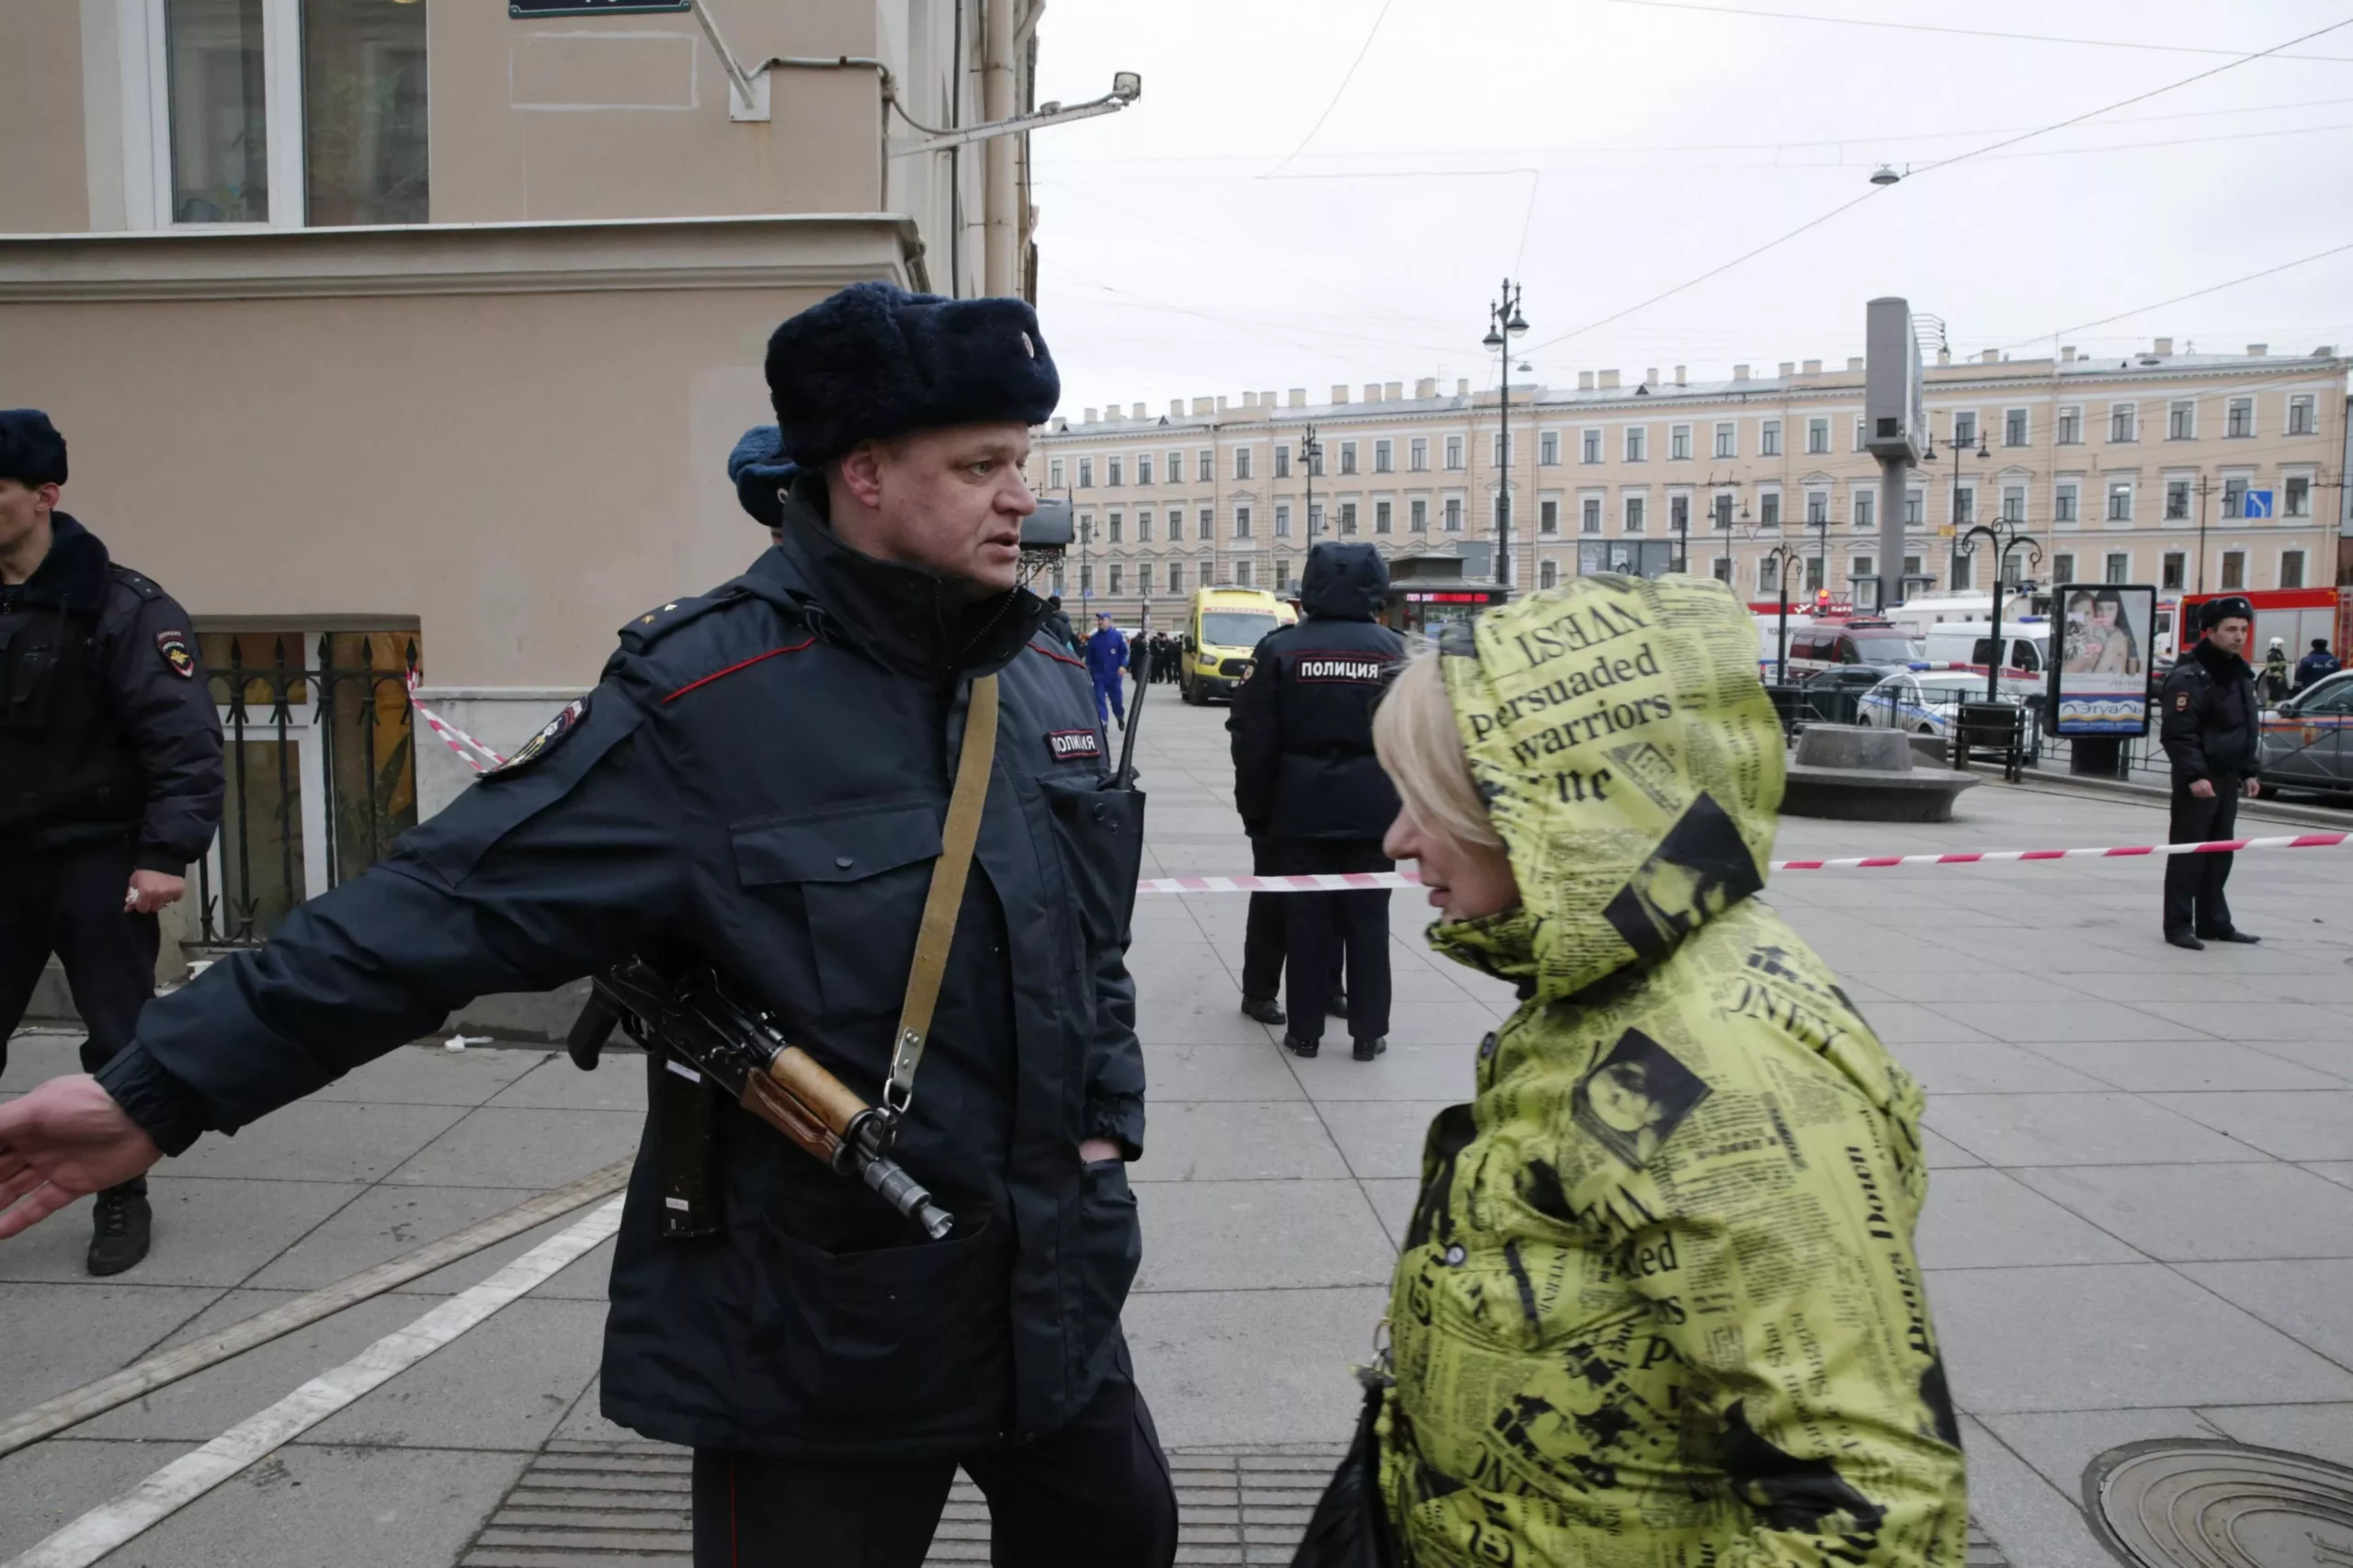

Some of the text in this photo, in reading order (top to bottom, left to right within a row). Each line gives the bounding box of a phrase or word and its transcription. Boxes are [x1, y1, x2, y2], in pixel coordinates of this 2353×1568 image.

[1302, 662, 1379, 679] ПОЛИЦИЯ
[1510, 693, 1673, 767] warriors
[1051, 735, 1096, 753] ПОЛИЦИЯ
